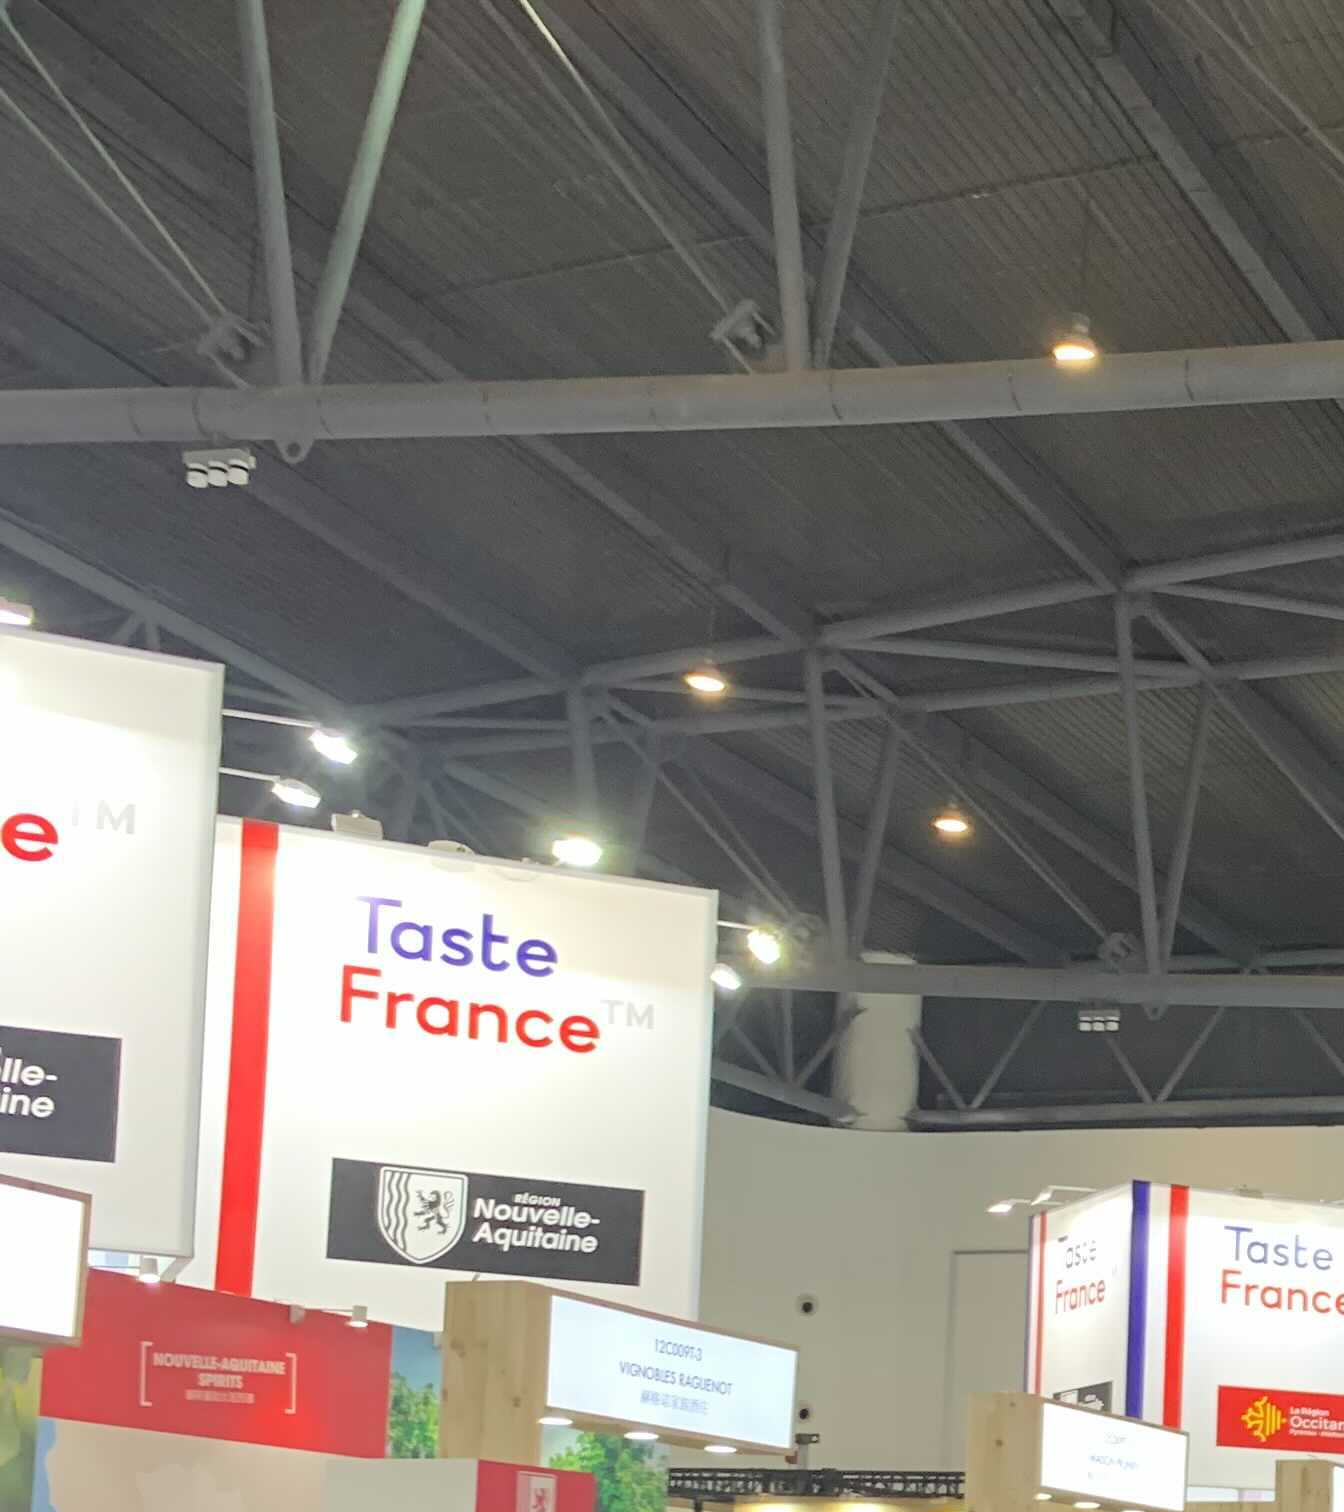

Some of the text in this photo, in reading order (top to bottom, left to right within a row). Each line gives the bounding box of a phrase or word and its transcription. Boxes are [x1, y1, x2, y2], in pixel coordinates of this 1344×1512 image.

[357, 896, 559, 978] Taste
[338, 964, 602, 1054] France
[473, 1198, 600, 1229] Nouvelle-
[472, 1221, 599, 1253] Aquitaine
[1224, 1225, 1334, 1271] Taste
[1054, 1279, 1107, 1314] France
[197, 1373, 243, 1389] SPIRITS
